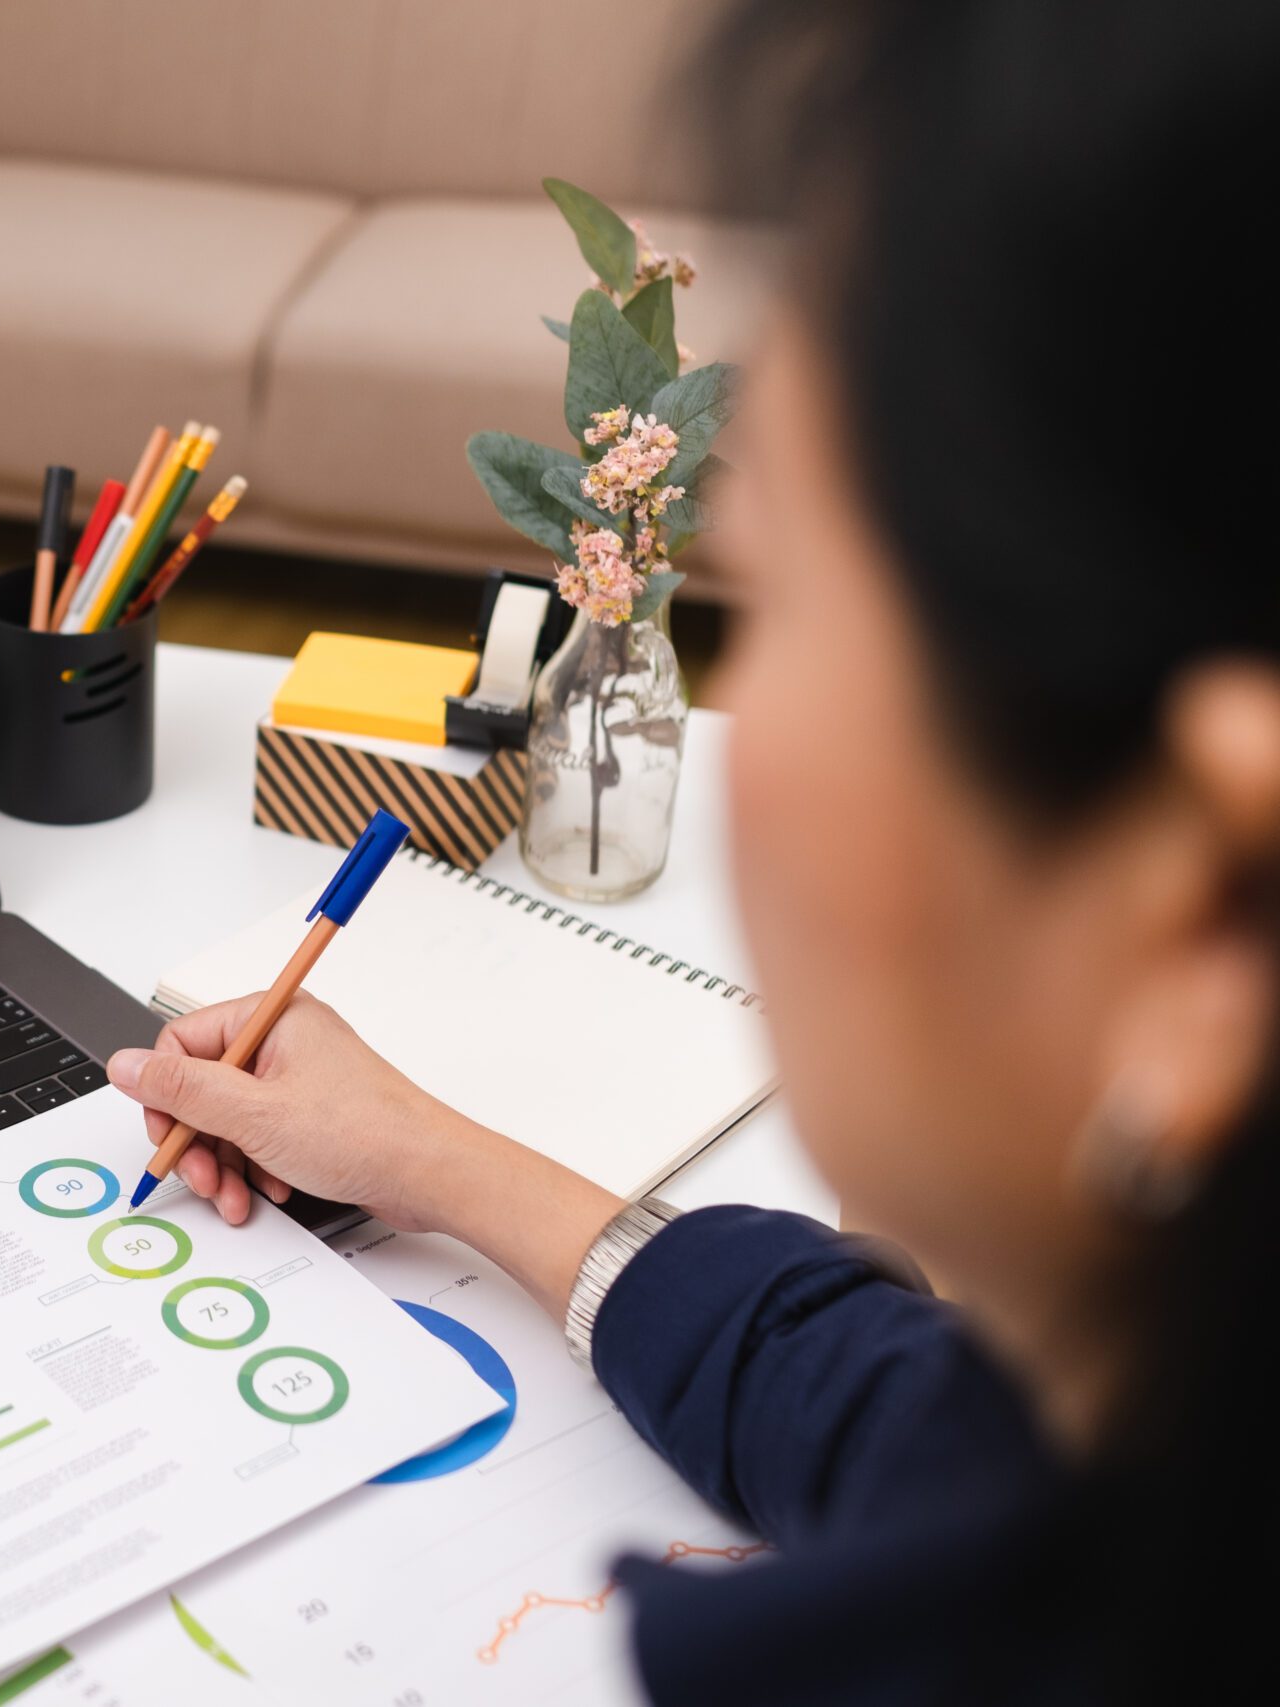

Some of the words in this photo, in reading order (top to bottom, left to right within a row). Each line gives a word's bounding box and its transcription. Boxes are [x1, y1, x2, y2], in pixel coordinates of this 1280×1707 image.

[56, 1179, 84, 1196] 90
[124, 1238, 152, 1256] 50
[355, 1232, 397, 1255] September
[454, 1273, 479, 1288] 35%
[199, 1302, 229, 1323] 75
[272, 1370, 313, 1397] 125
[297, 1597, 329, 1625] 20
[345, 1641, 375, 1666] 15
